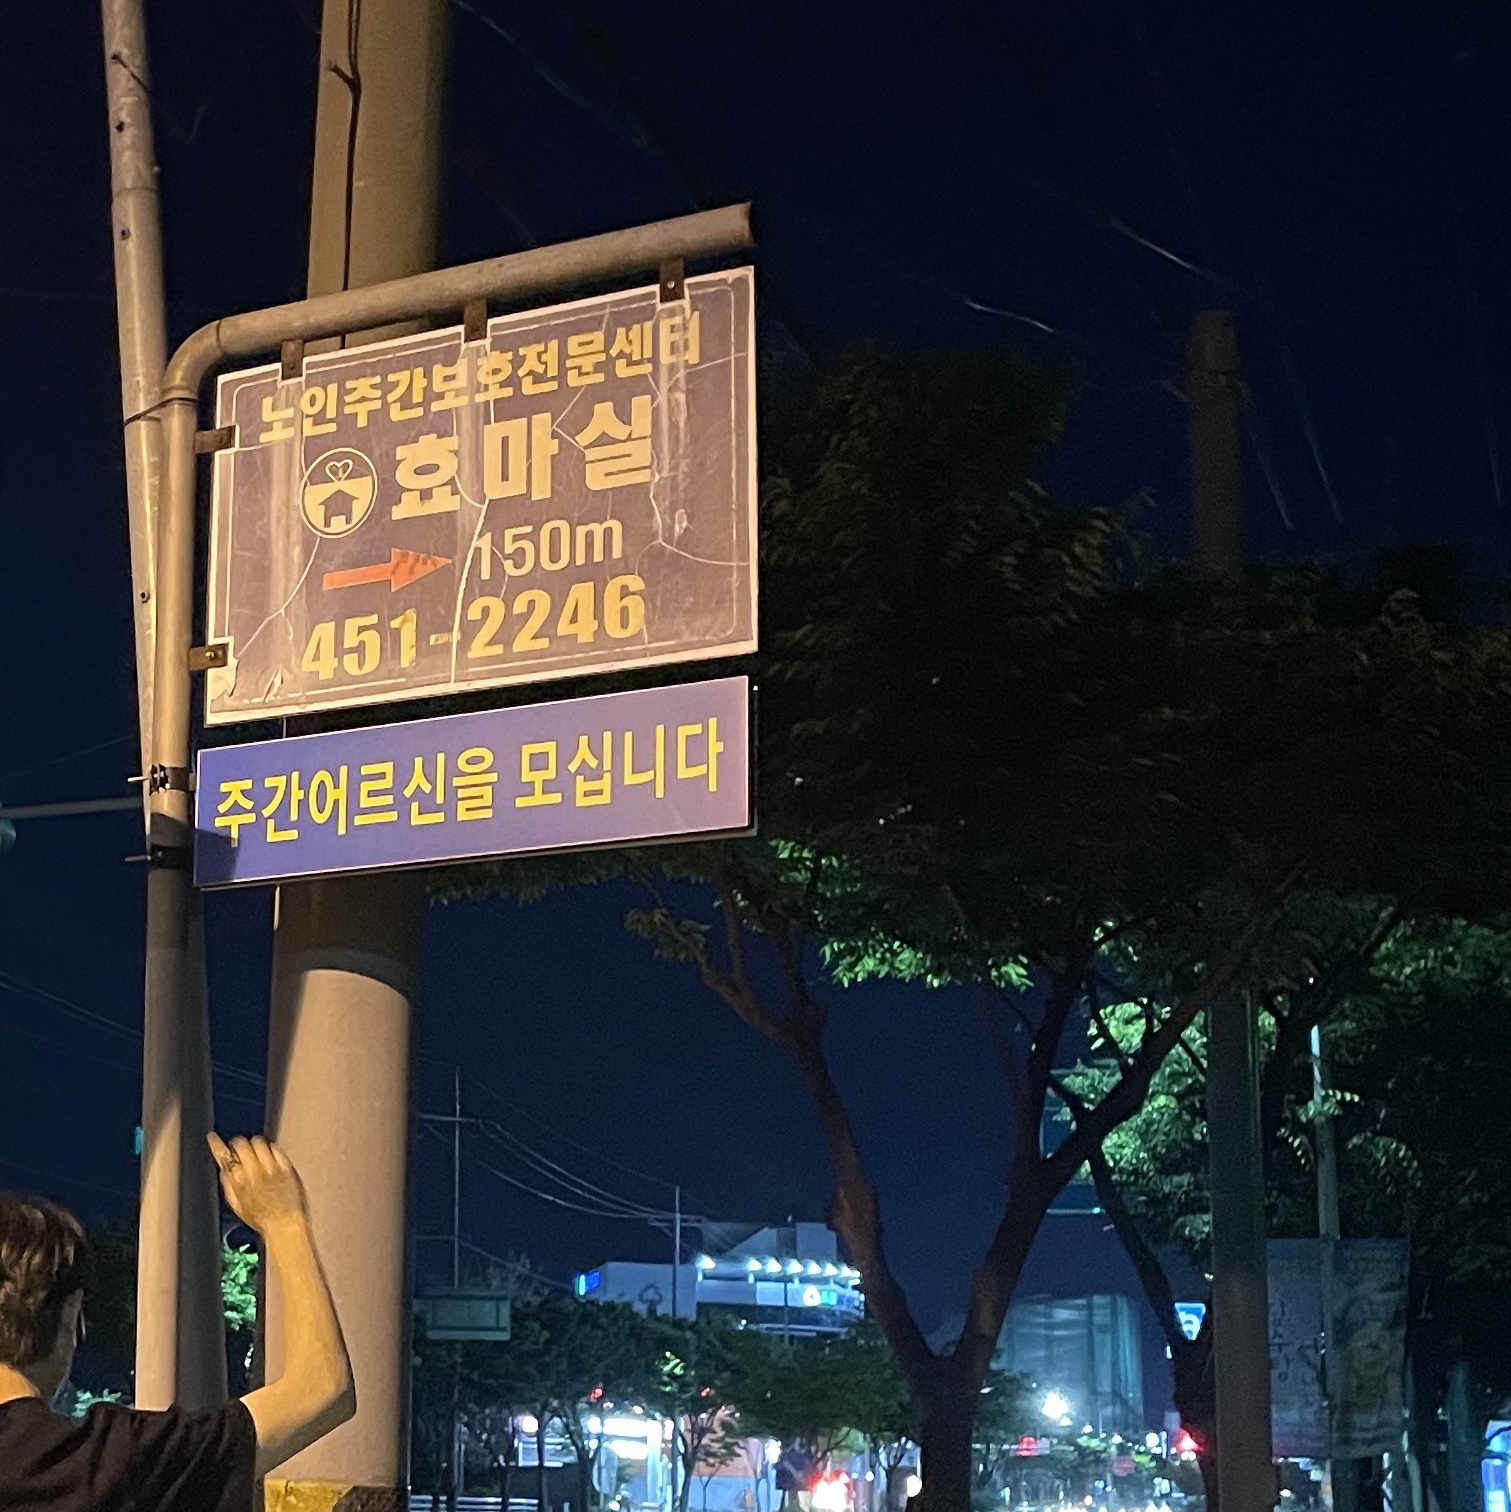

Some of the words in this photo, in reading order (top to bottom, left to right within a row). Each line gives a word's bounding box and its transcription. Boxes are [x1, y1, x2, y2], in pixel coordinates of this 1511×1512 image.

[259, 310, 701, 444] 노인주간보호전문센터
[392, 395, 654, 521] 효마실
[475, 518, 624, 580] 150m
[302, 574, 645, 680] 451-2246
[214, 746, 500, 848] 주간어르신을
[513, 716, 724, 810] 모십니다
